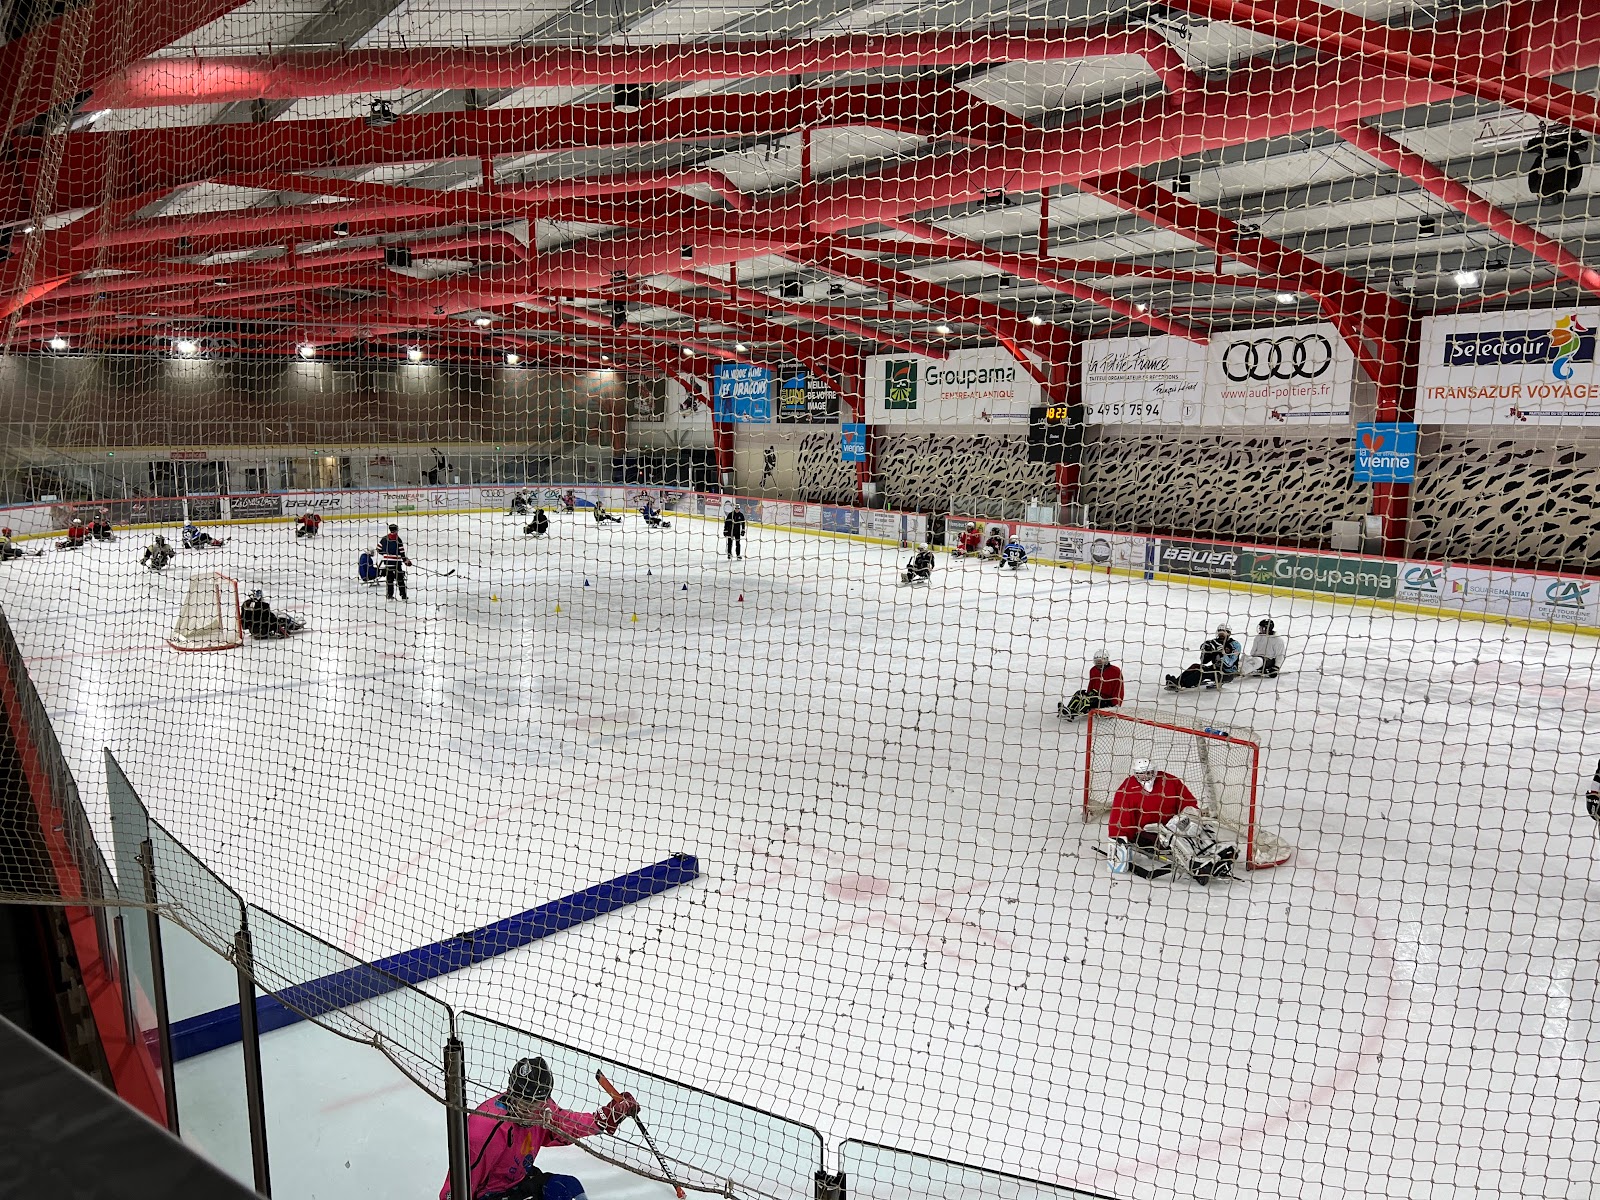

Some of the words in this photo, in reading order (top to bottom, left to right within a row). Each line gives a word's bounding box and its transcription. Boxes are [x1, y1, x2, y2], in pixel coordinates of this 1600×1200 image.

[1452, 341, 1544, 357] Selectour
[925, 365, 1016, 389] Groupama
[941, 390, 1015, 400] CENTRE-ATLANTIQUE
[1220, 383, 1331, 400] www.audi-poitiers.fr
[1426, 386, 1522, 400] TRANSAZUR
[1527, 384, 1600, 399] VOYAGE
[807, 401, 826, 411] IMAGE
[1097, 404, 1110, 416] 49
[1129, 404, 1142, 416] 75
[1145, 404, 1160, 416] 94
[1359, 456, 1410, 469] vienne
[285, 498, 341, 508] BAUER
[1162, 548, 1238, 567] BAUER
[1274, 559, 1391, 589] Groupama
[1499, 589, 1531, 599] HABITAT
